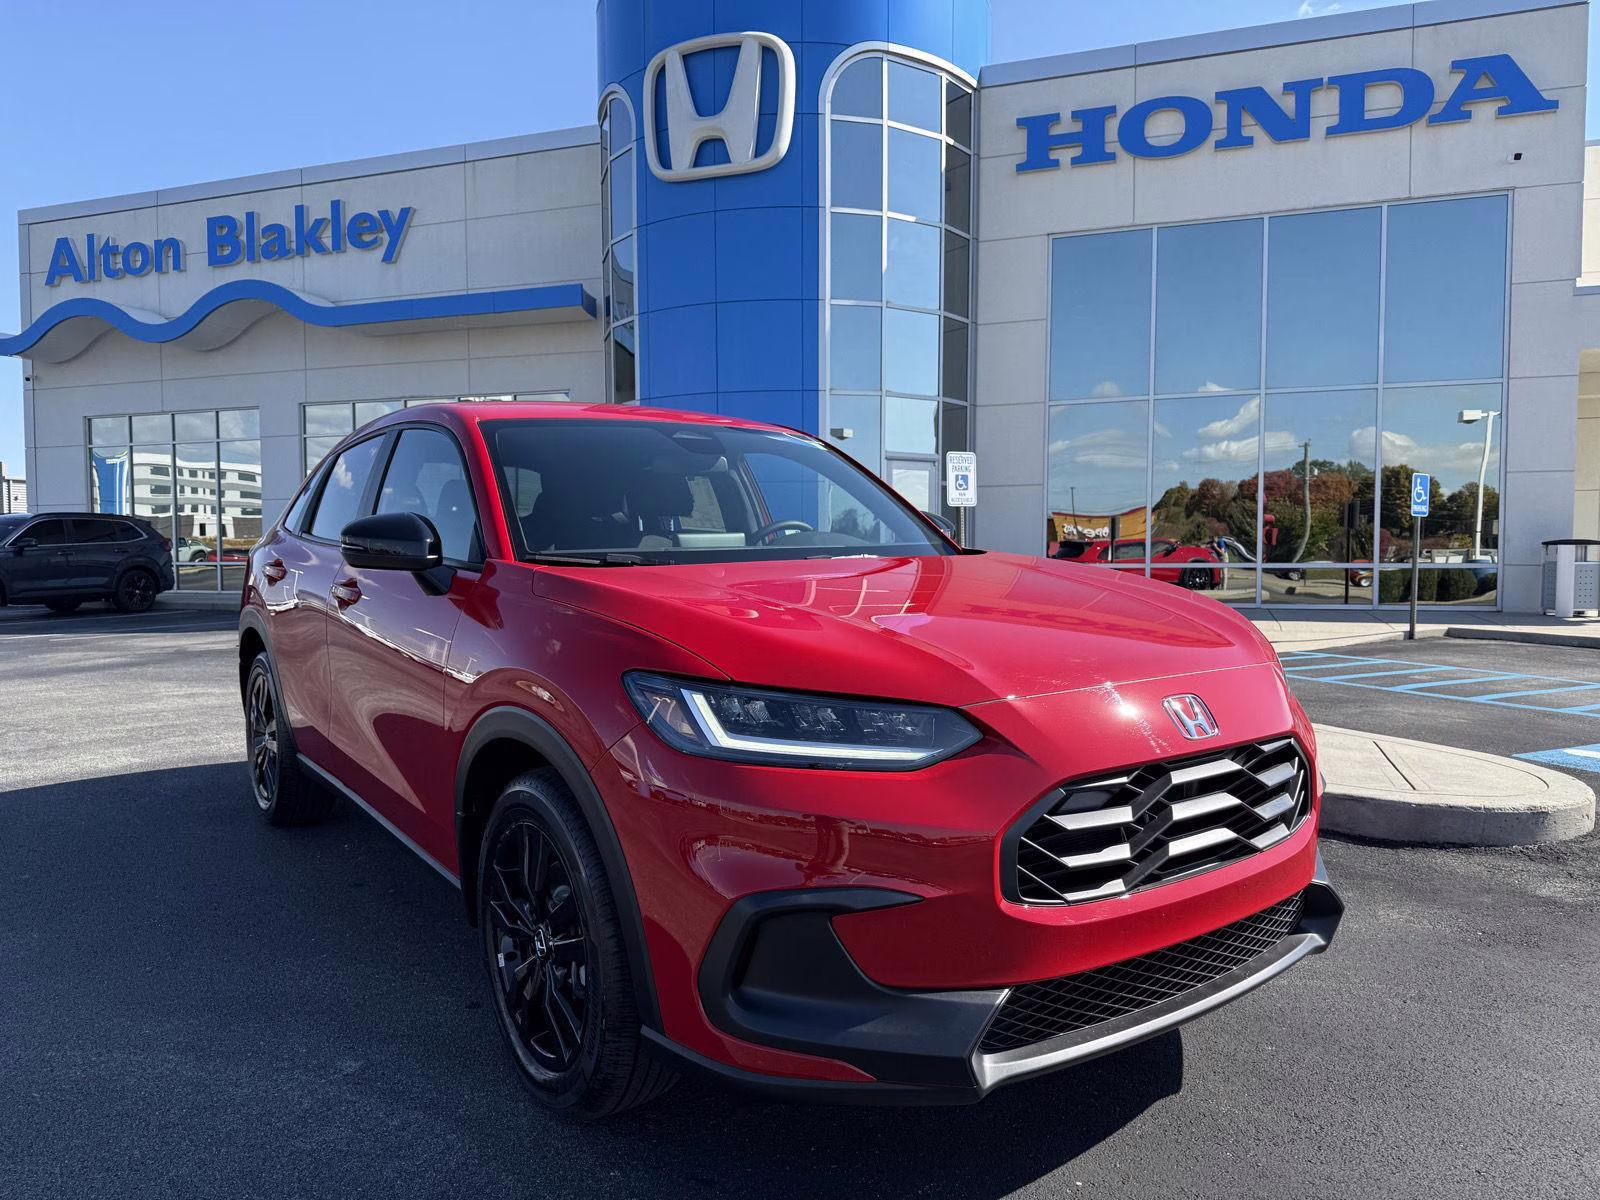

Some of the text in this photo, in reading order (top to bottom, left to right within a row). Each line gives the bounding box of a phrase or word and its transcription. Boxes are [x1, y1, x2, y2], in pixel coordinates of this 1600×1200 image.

[1016, 53, 1560, 174] HONDA
[45, 199, 416, 287] Alton Blakley
[949, 456, 973, 464] RESERVED
